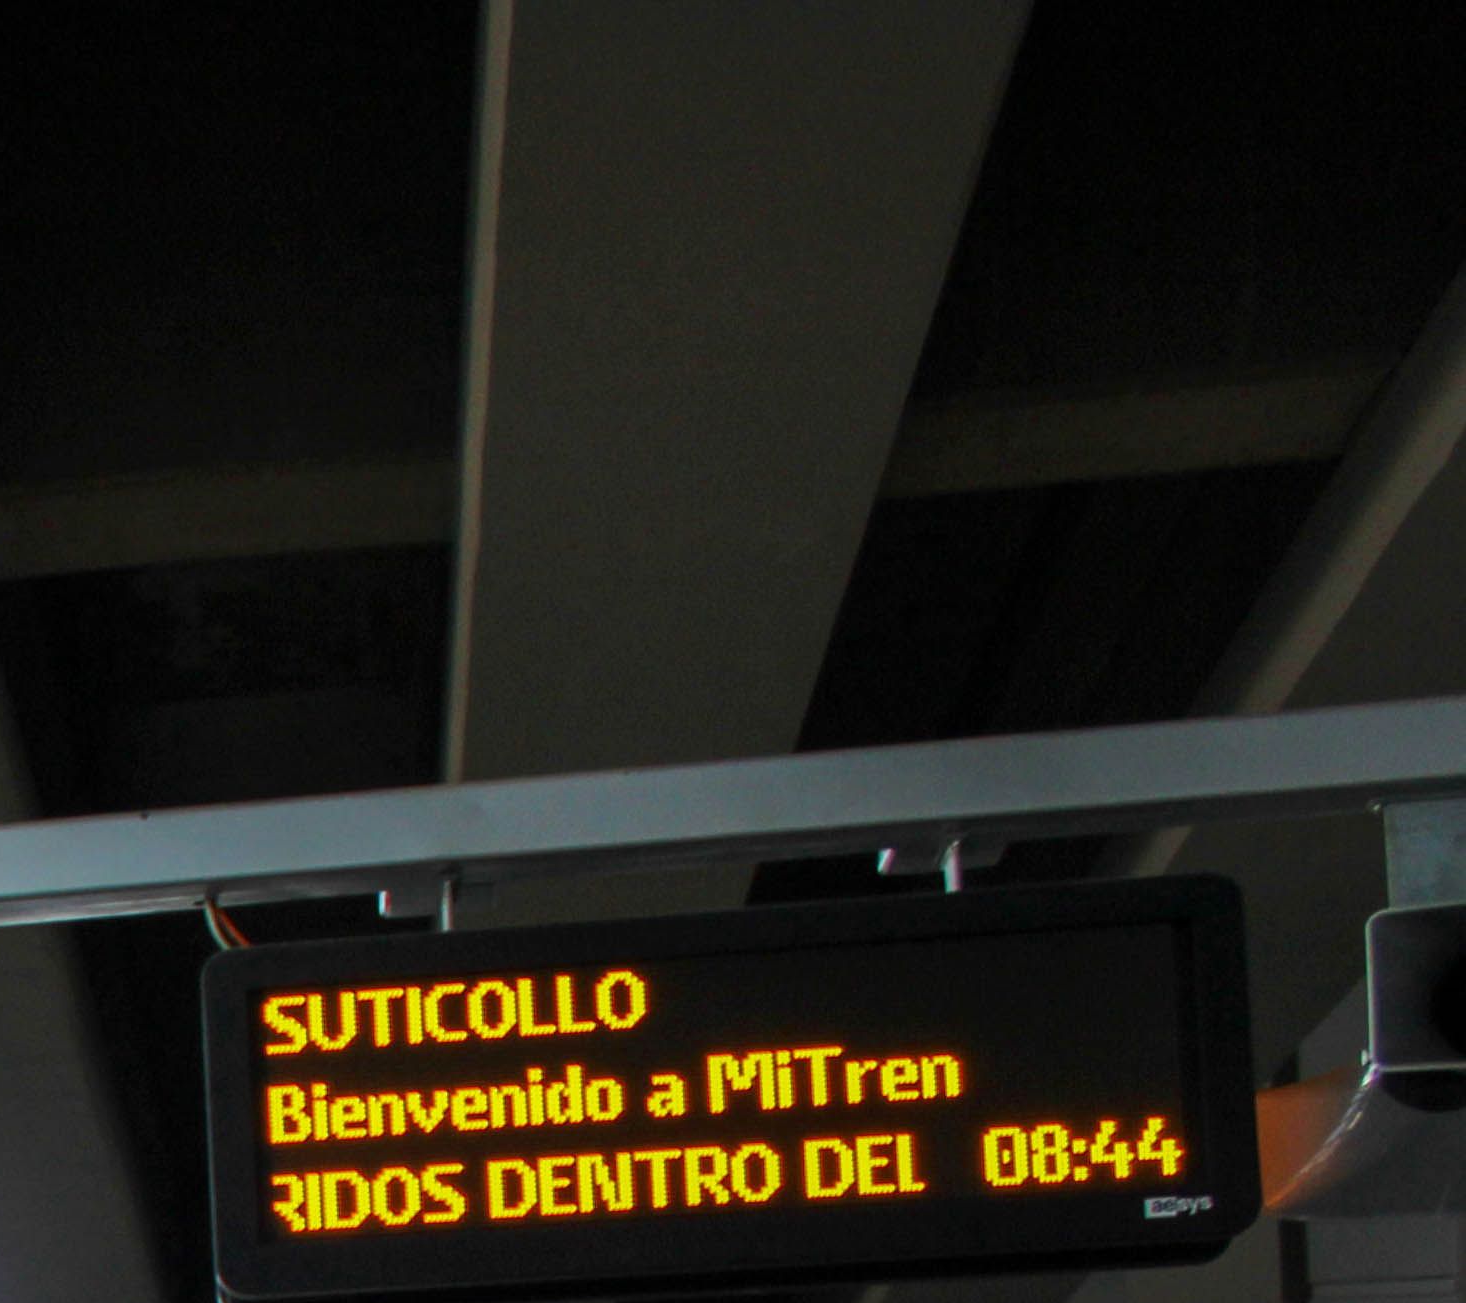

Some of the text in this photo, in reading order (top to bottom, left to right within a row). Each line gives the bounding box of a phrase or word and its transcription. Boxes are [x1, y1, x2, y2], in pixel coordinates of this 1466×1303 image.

[263, 970, 647, 1055] SUTICOLLO
[266, 1046, 961, 1145] Bienvenido a MiTren
[486, 1142, 782, 1220] DENTRO
[803, 1133, 926, 1199] DEL
[983, 1116, 1183, 1188] 08:44
